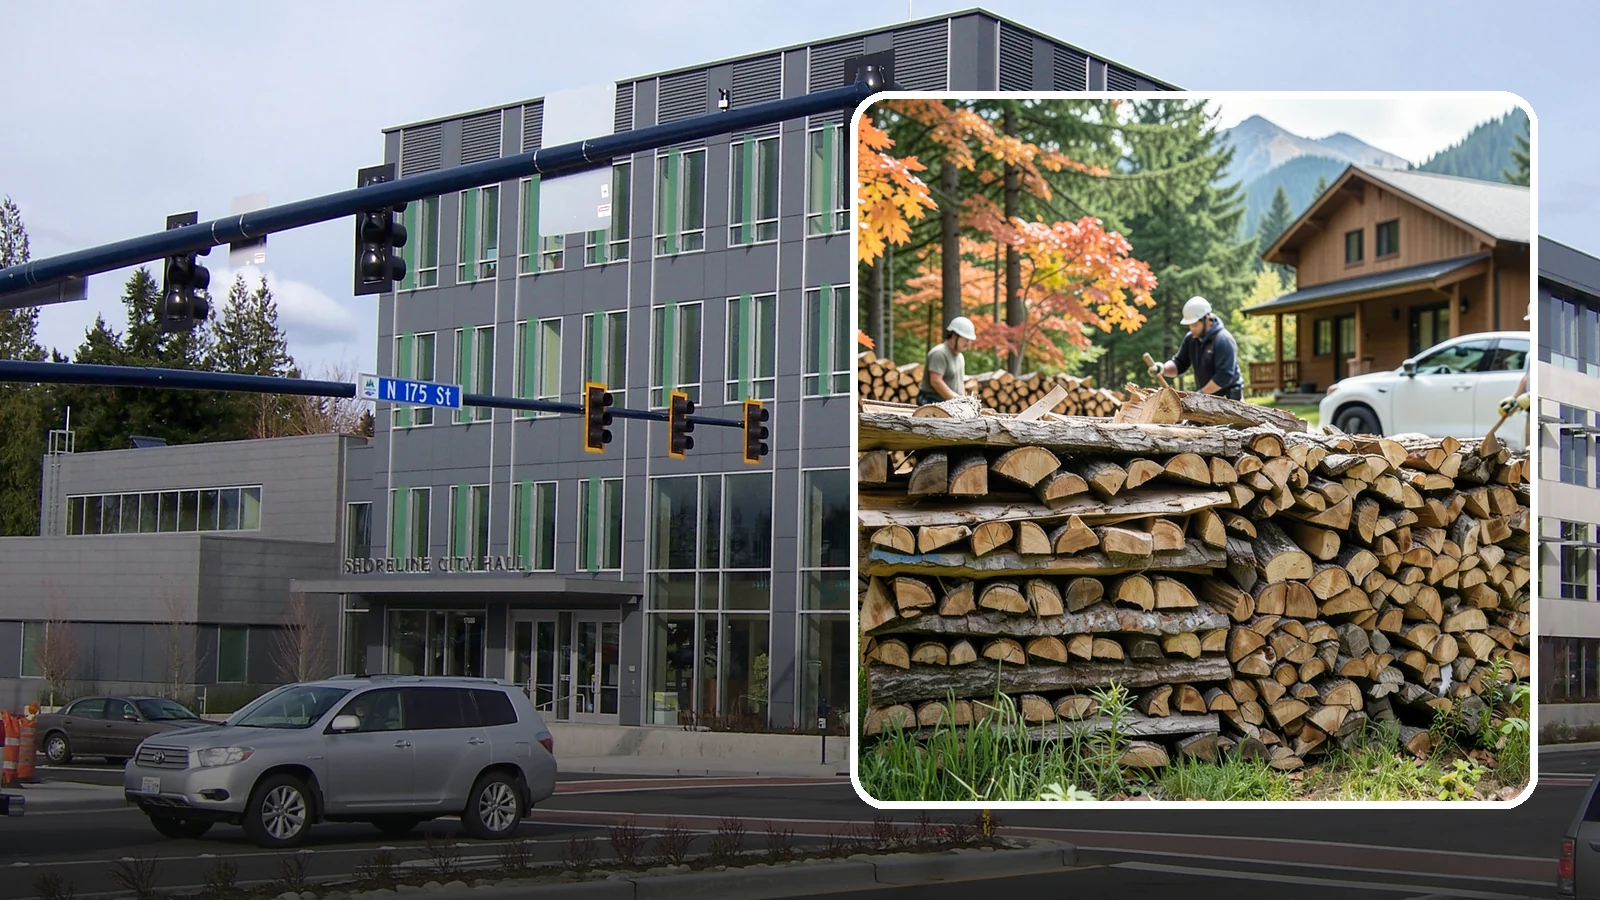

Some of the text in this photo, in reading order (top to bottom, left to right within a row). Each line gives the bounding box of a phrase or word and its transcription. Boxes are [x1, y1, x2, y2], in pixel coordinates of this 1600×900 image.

[387, 380, 451, 405] N 175 St
[344, 555, 526, 574] SHORELINE CITY HALL
